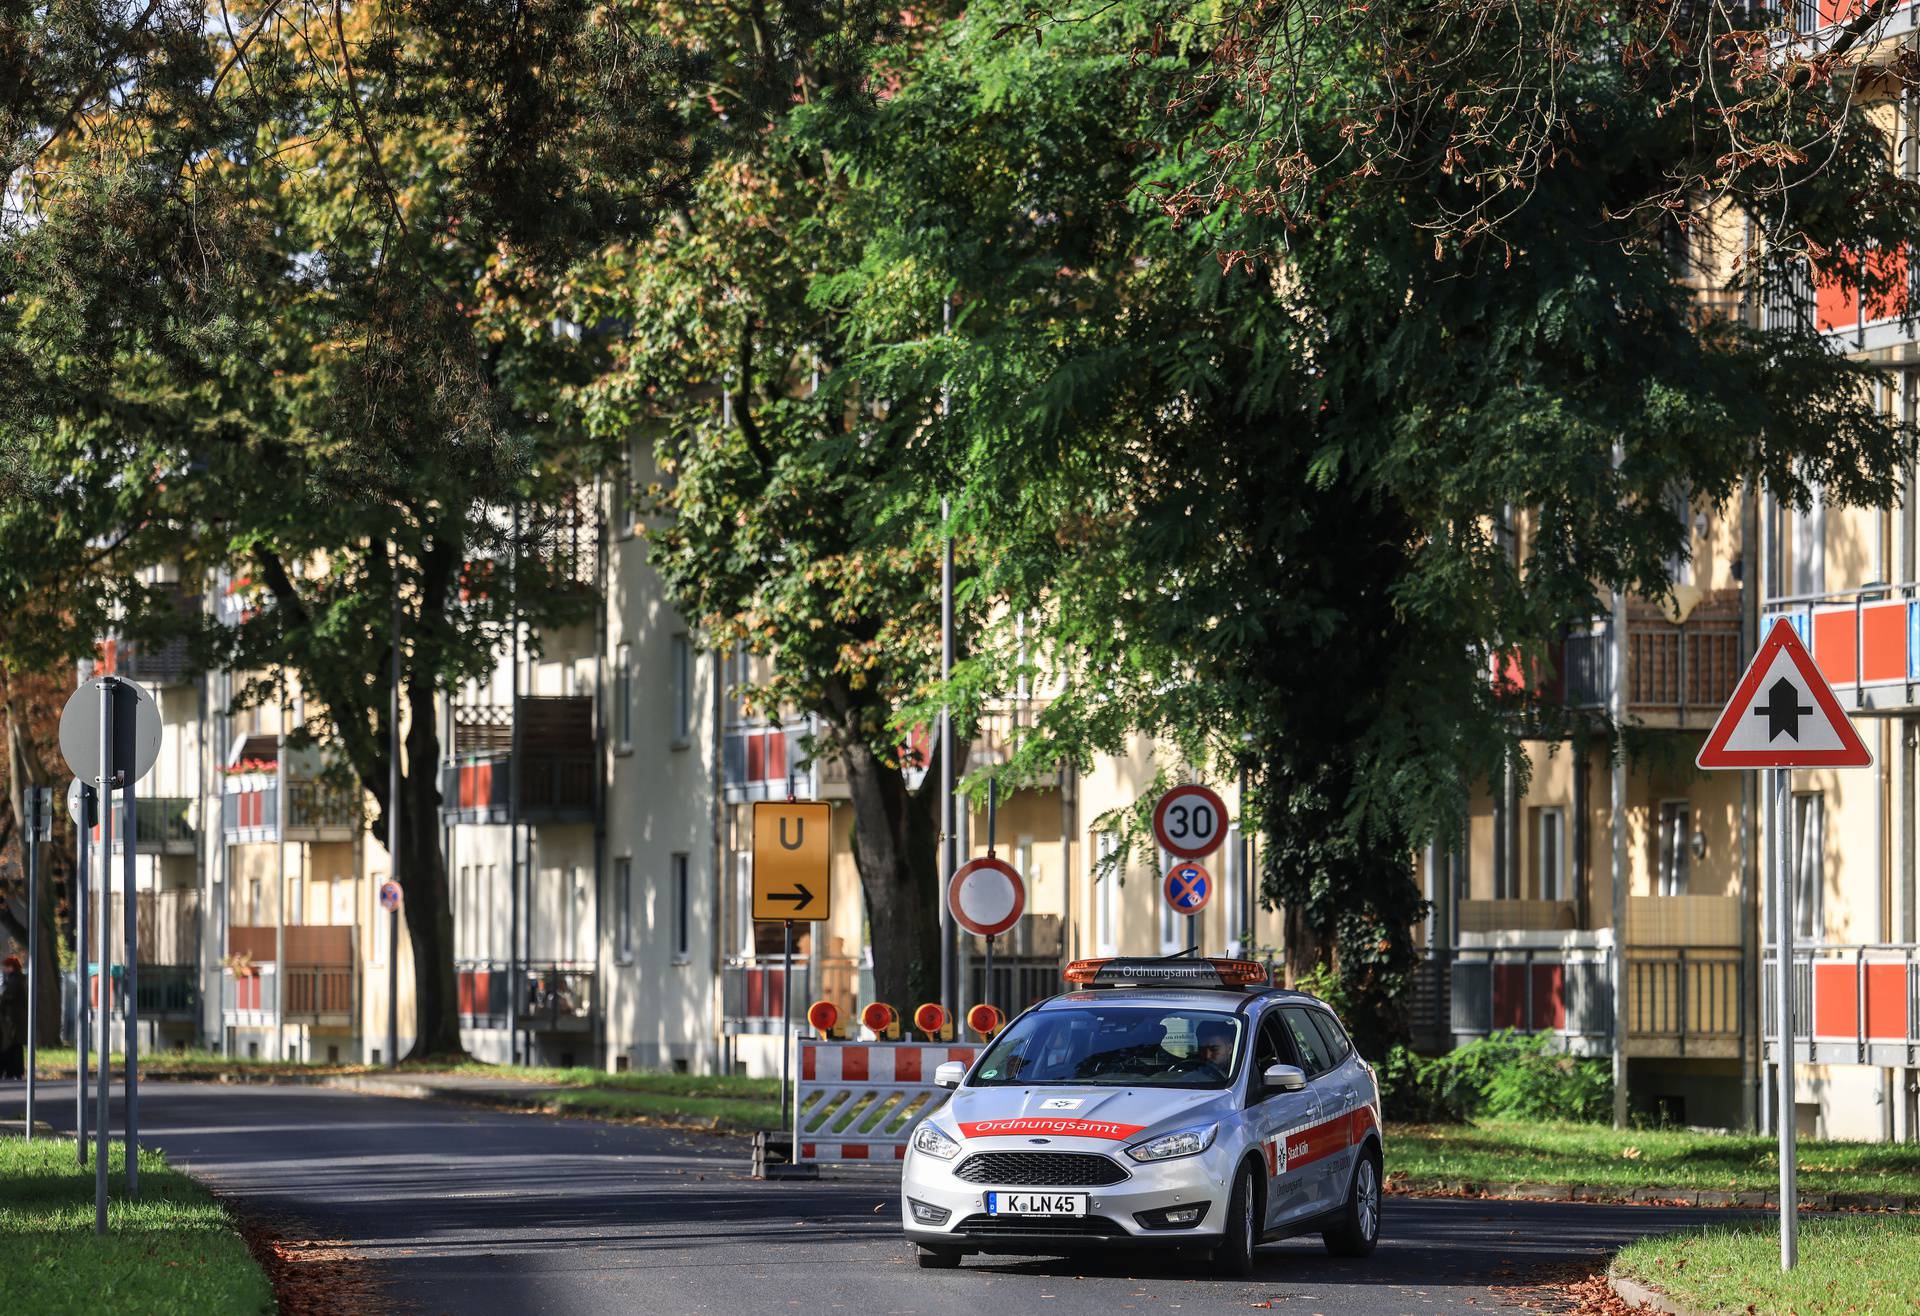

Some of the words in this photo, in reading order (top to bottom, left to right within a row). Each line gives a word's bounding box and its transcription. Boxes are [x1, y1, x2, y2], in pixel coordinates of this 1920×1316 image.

[1169, 805, 1211, 838] 30
[780, 817, 803, 850] U
[1123, 965, 1197, 979] Ordnungsamt
[975, 1118, 1121, 1134] Ordnungsamt
[1008, 1195, 1019, 1212] K
